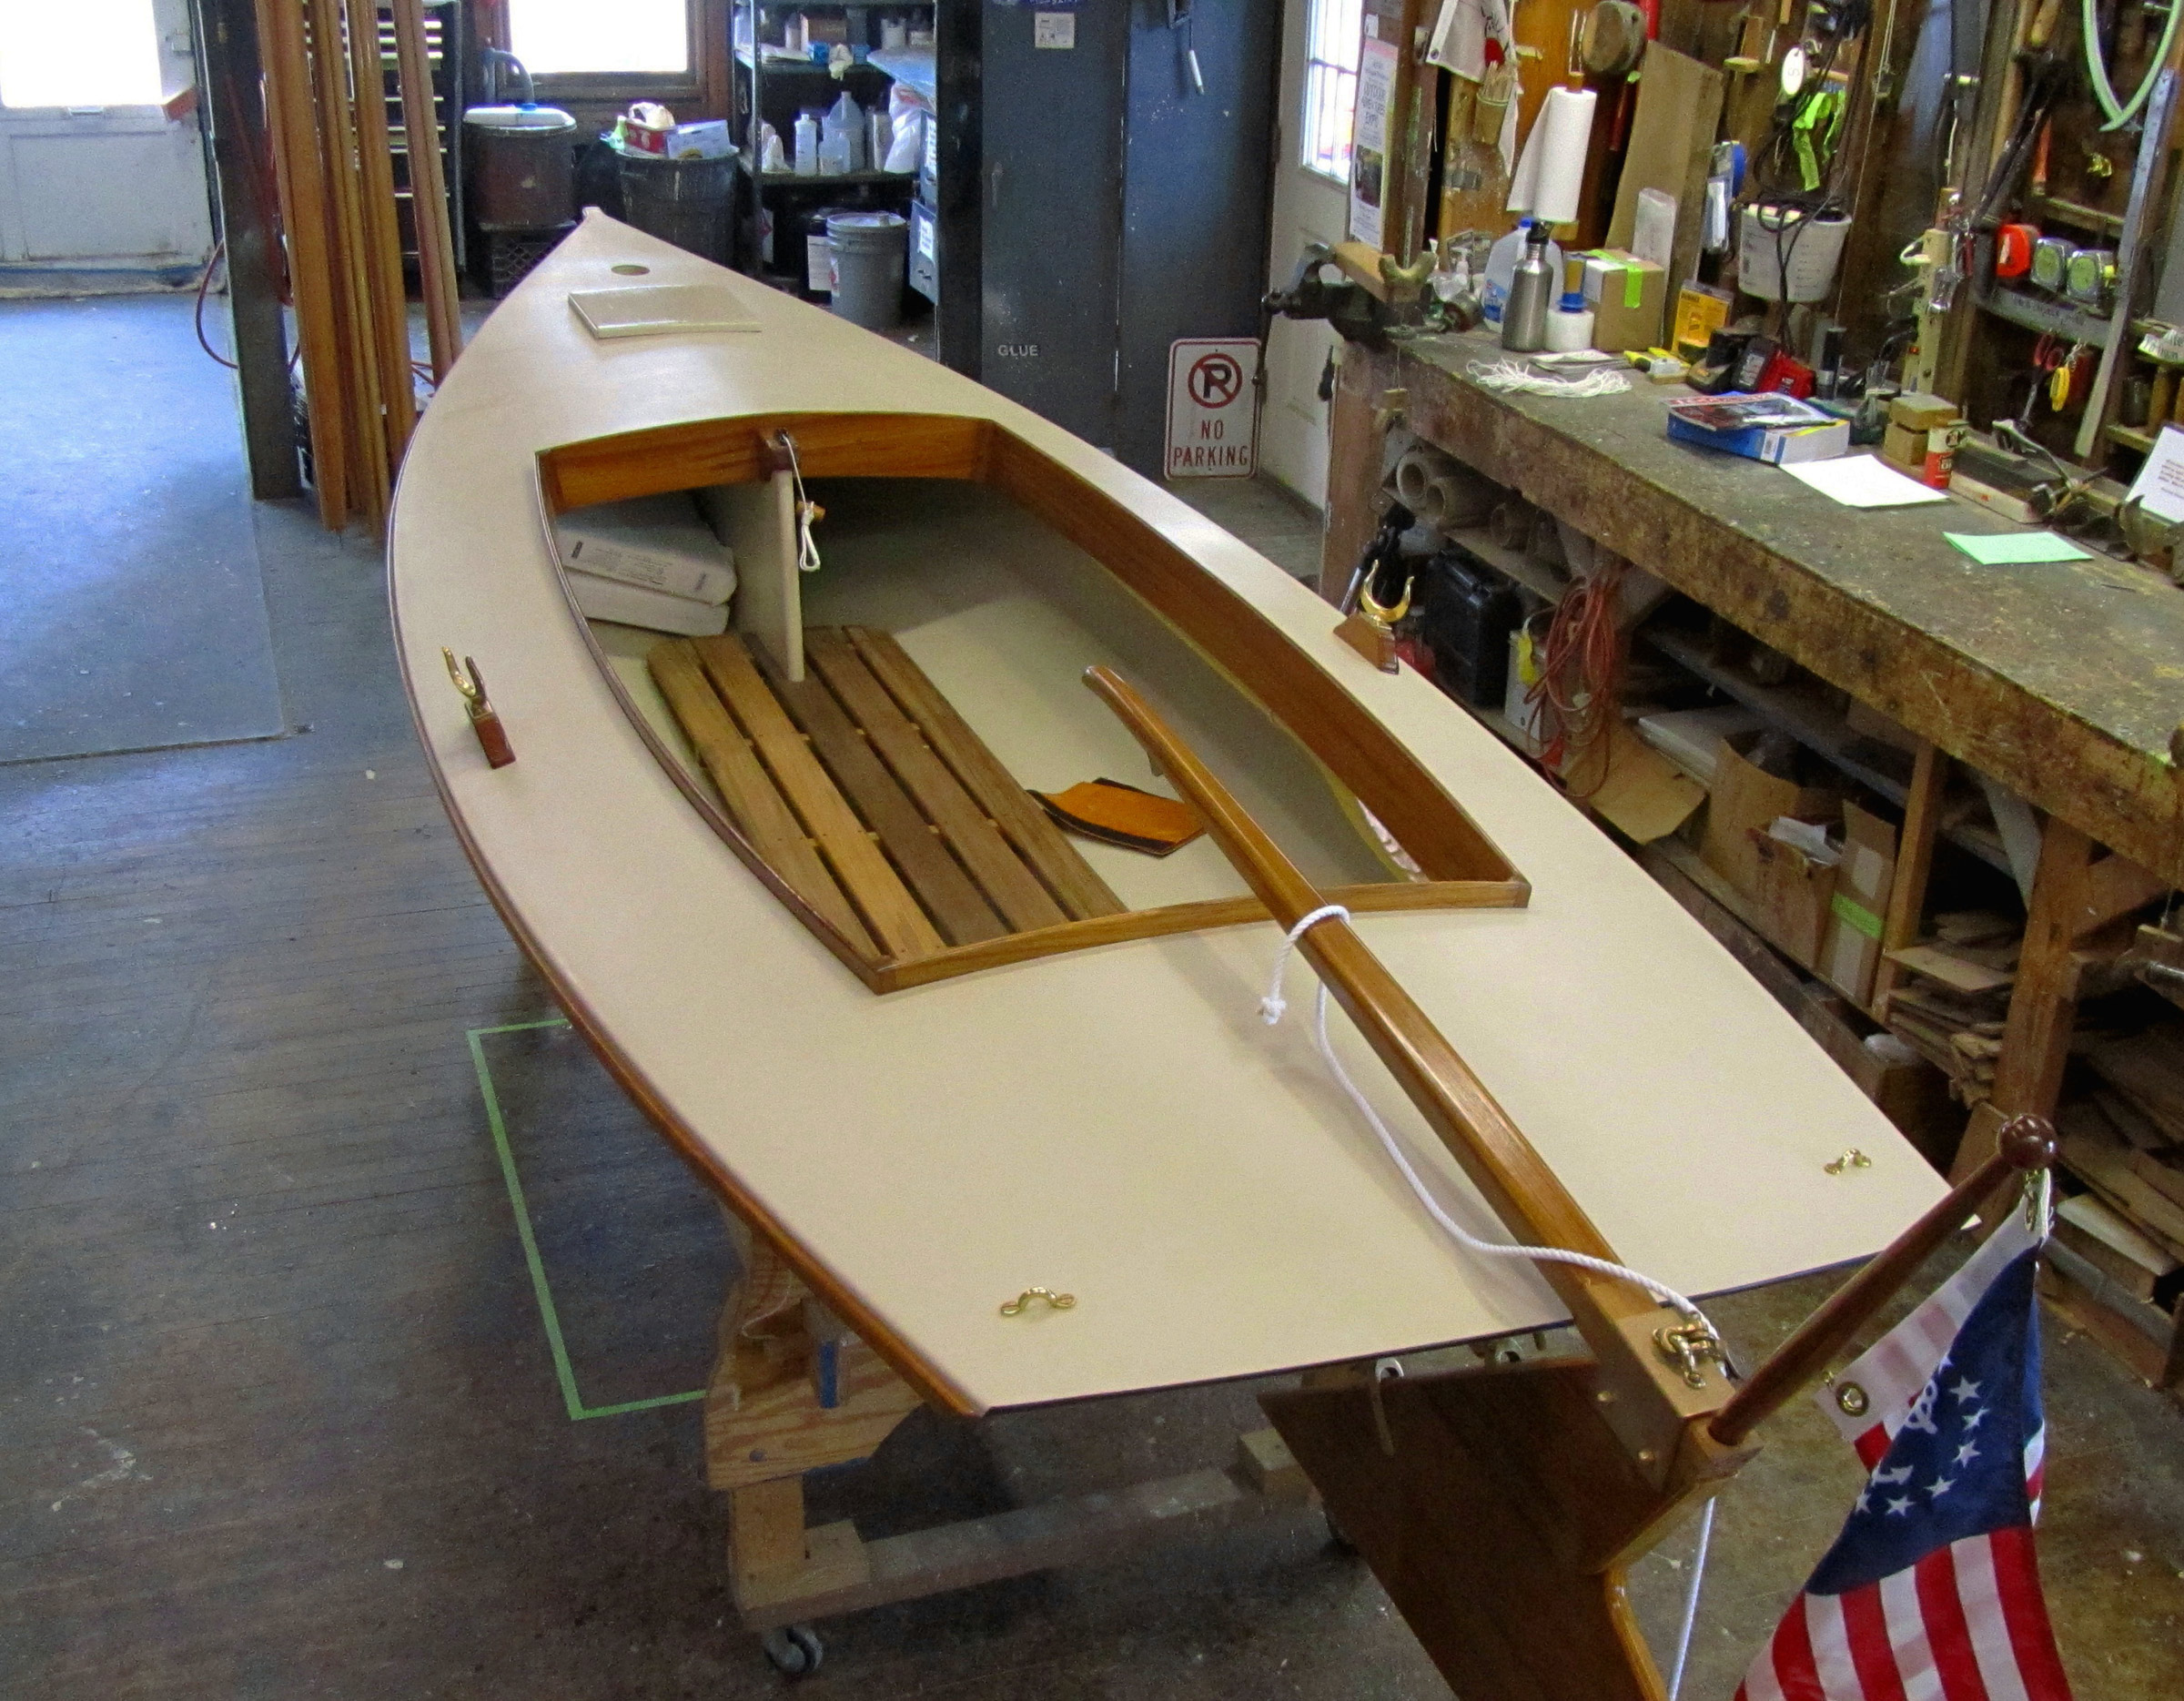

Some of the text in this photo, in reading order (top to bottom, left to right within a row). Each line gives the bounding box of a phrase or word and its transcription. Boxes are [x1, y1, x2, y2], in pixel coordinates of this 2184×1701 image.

[997, 344, 1039, 357] GLUE
[1200, 419, 1224, 440] NO
[1173, 445, 1249, 467] PARKING
